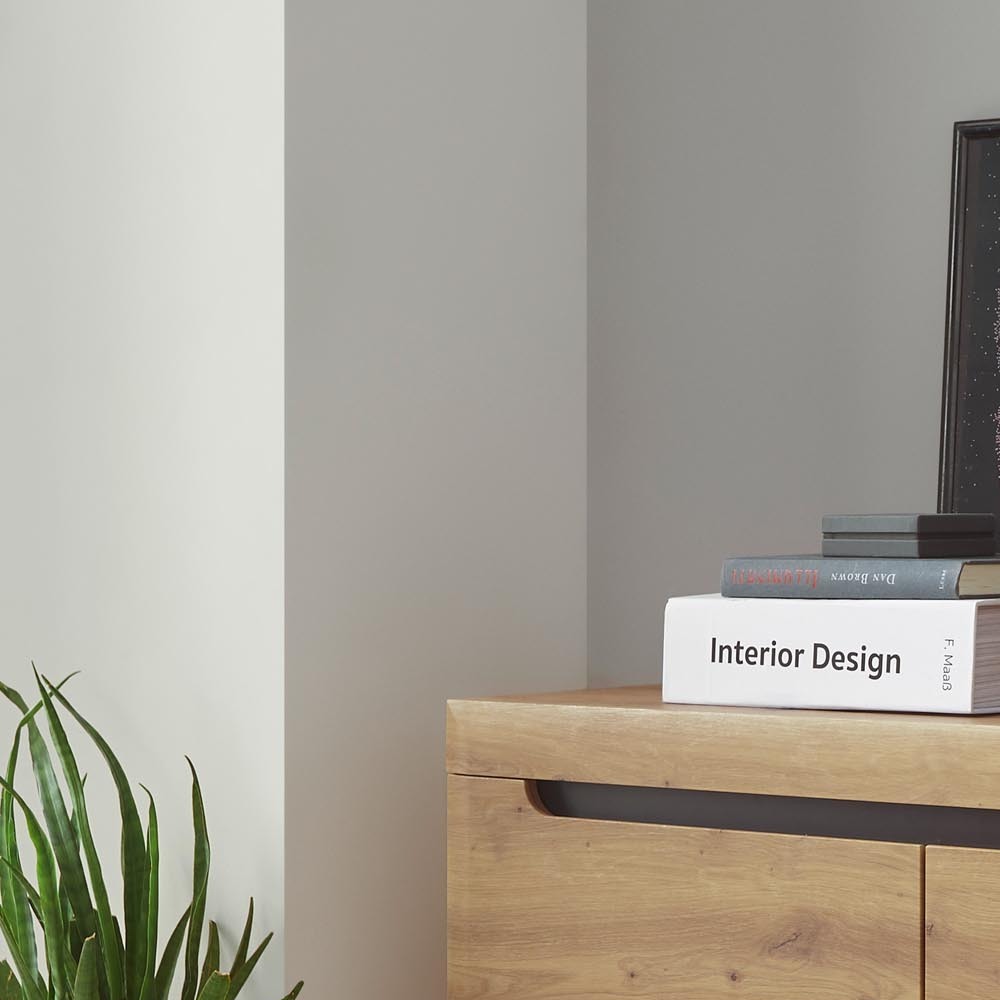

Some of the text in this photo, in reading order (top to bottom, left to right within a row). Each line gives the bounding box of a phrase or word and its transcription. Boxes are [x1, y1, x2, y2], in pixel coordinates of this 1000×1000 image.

[831, 573, 896, 585] DAN BROWN
[710, 637, 902, 680] Interior Design
[942, 639, 954, 691] F. Maaß
